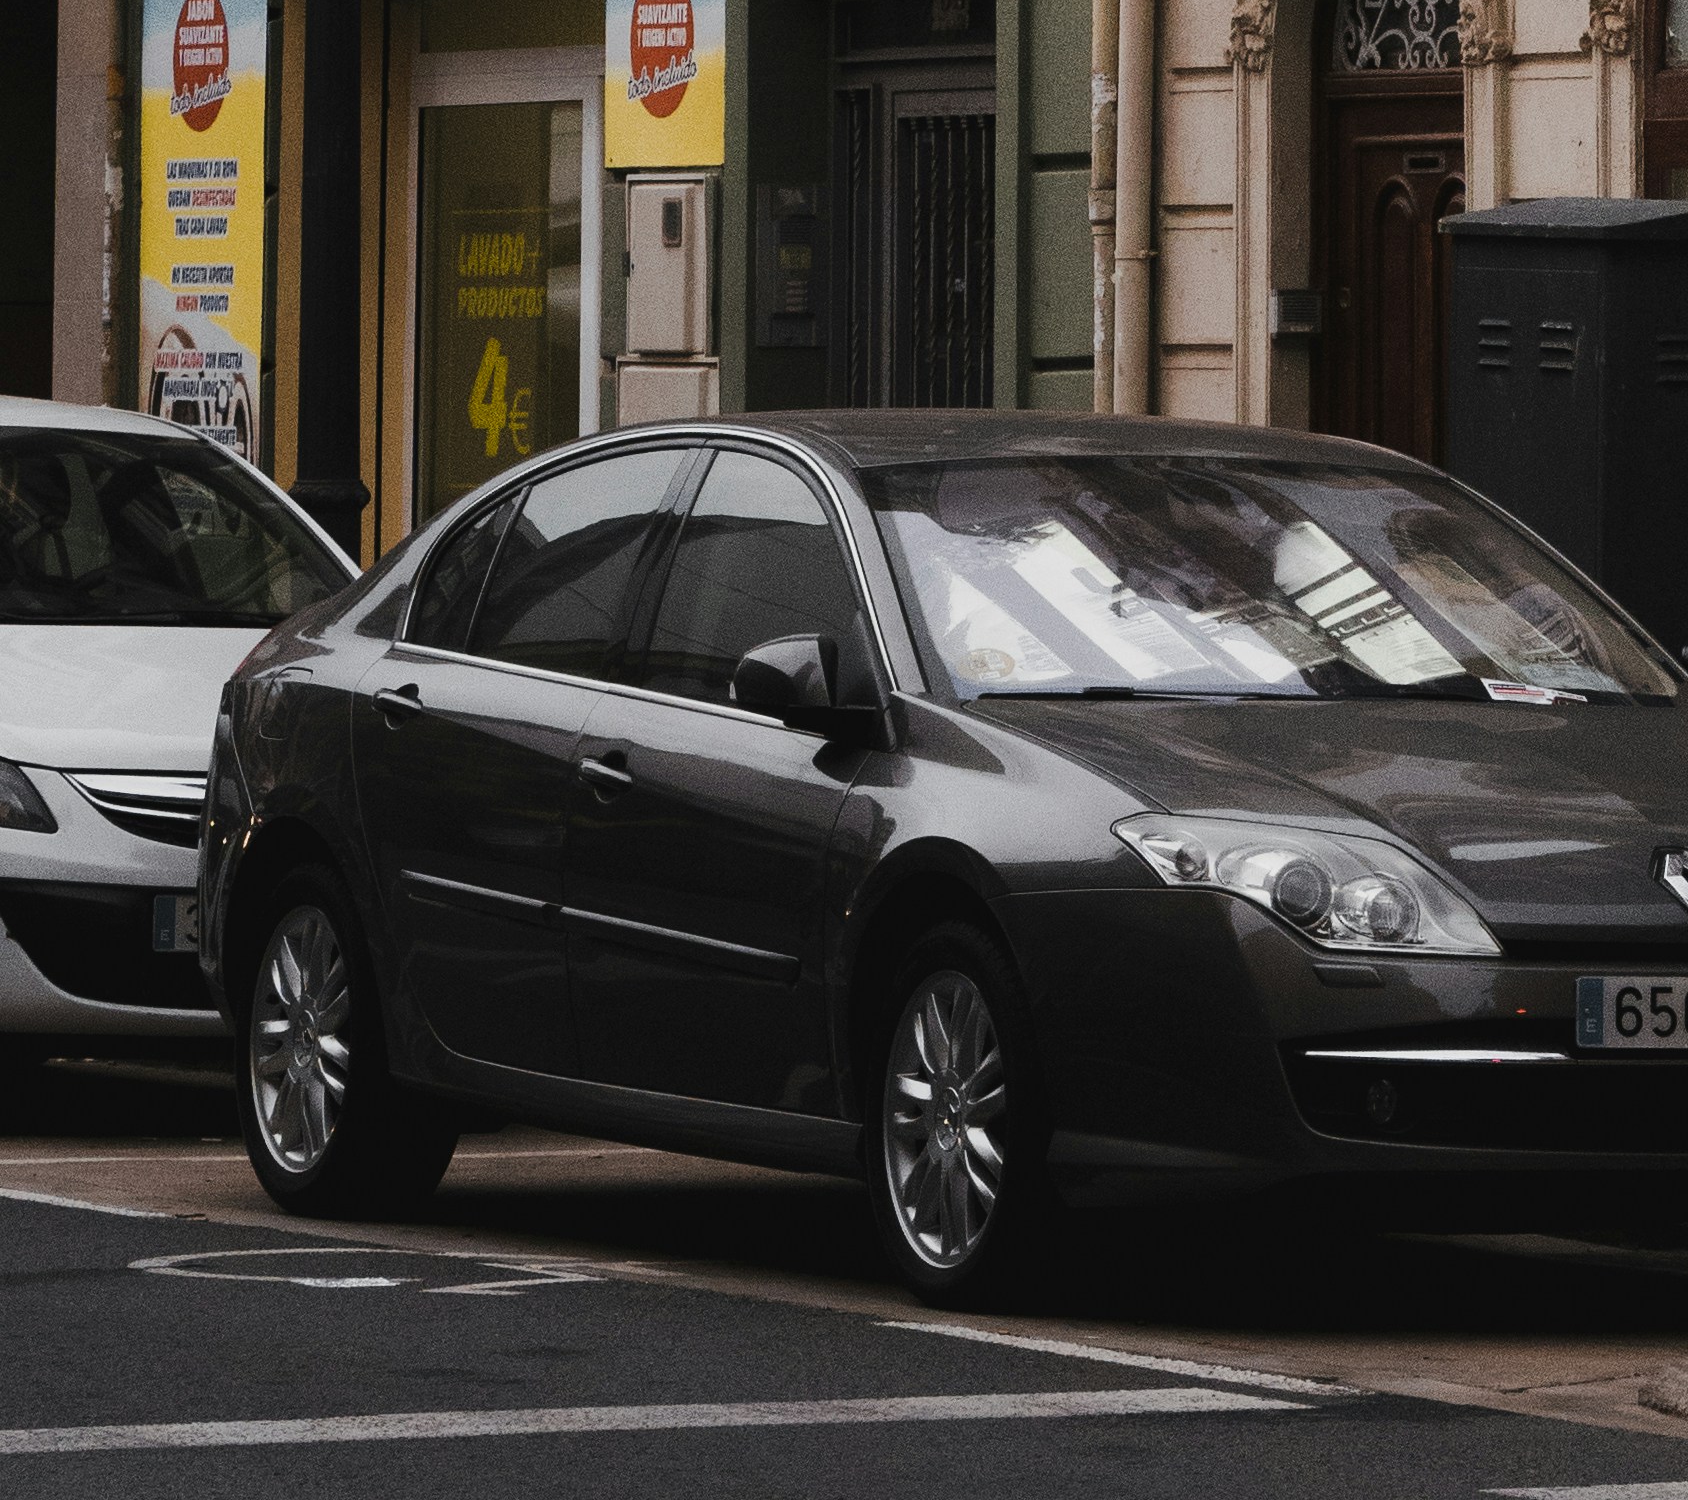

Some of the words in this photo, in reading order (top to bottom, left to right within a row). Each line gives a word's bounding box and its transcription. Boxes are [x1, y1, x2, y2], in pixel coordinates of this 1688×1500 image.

[637, 3, 688, 25] SUAVIZANTE
[179, 25, 224, 46] SUAVIZANTE
[458, 233, 525, 277] LAVADO
[457, 286, 547, 319] PRODUCTOS
